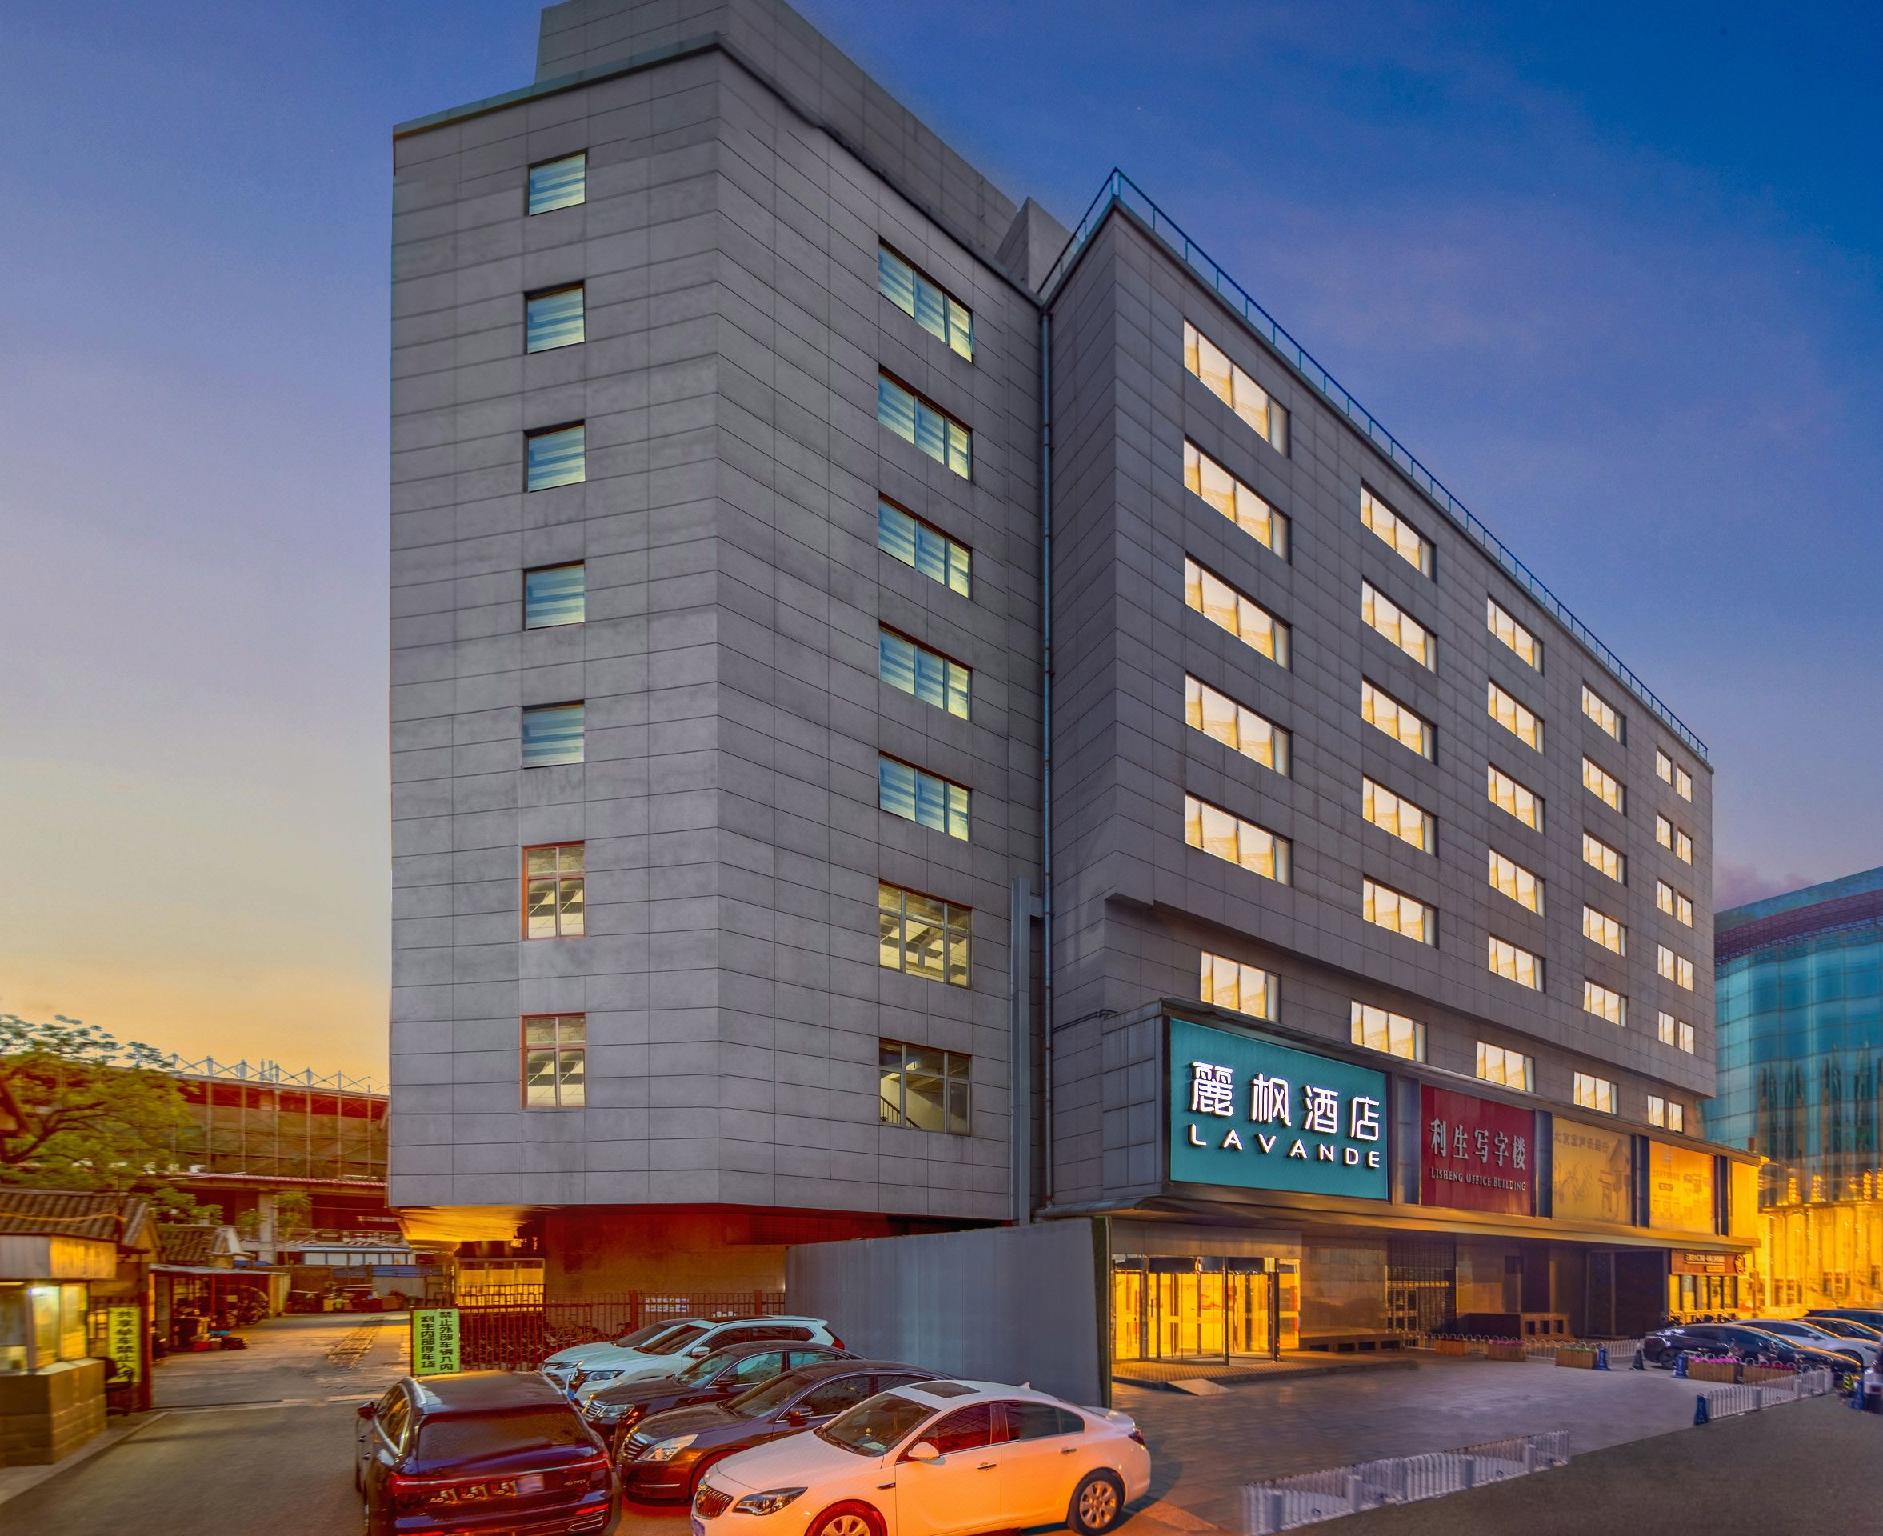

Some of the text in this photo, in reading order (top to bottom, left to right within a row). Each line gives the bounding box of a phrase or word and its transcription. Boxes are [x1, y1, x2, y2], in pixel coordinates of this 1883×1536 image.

[1190, 1061, 1381, 1141] 麗枫酒店
[1188, 1123, 1380, 1168] LAVANDE
[1430, 1117, 1526, 1170] 利生写字楼
[1431, 1166, 1526, 1191] LISHENG OFFICE BUILDING
